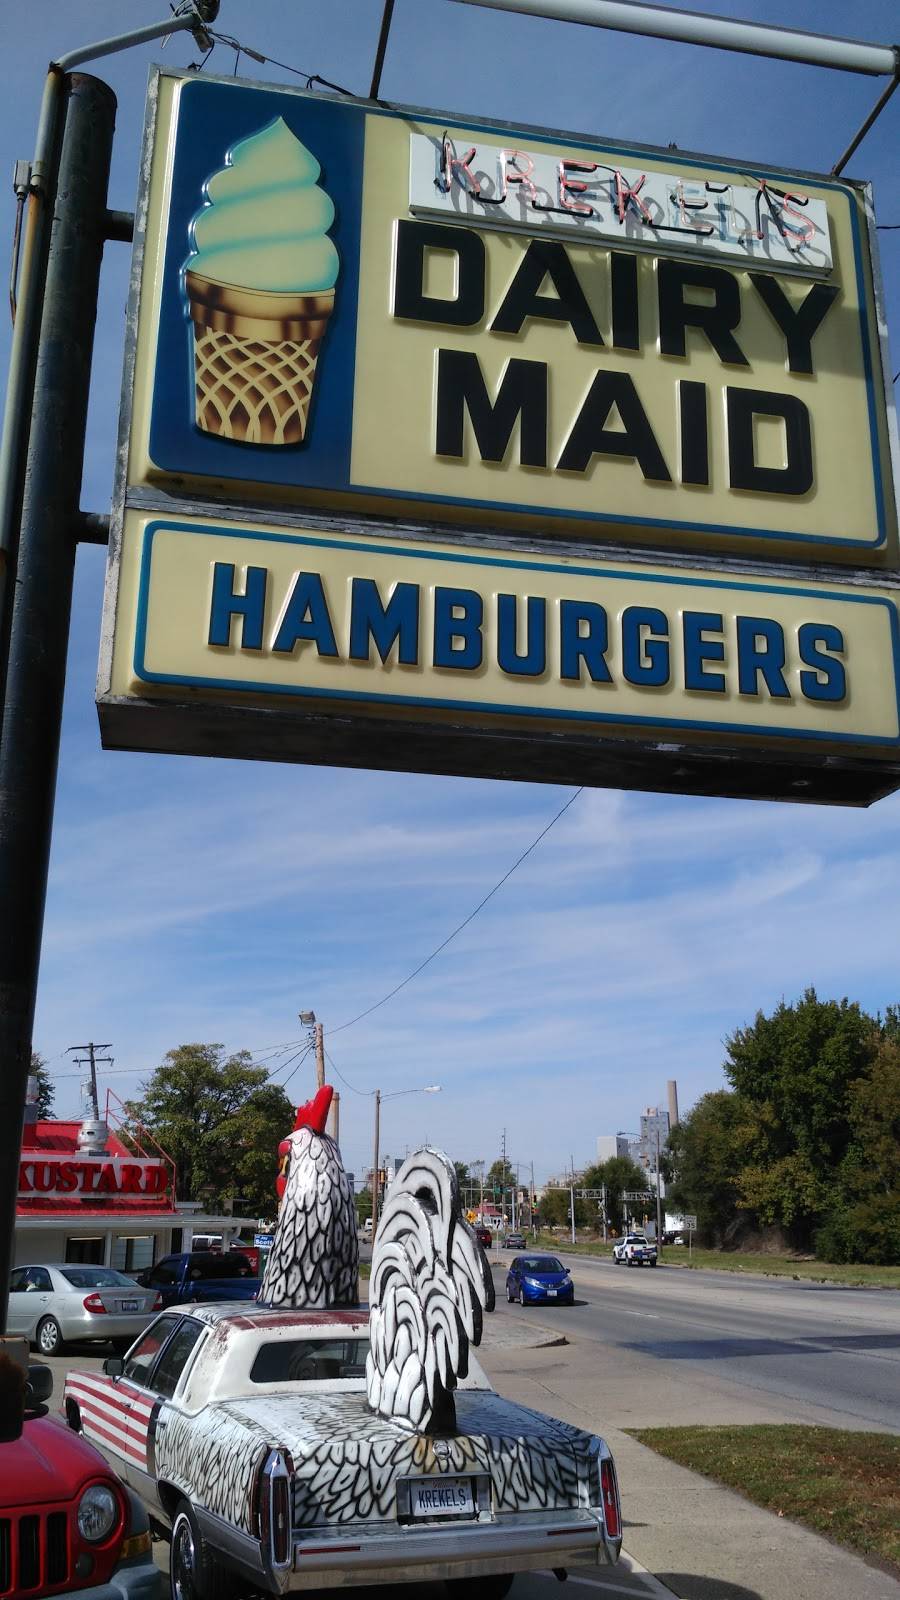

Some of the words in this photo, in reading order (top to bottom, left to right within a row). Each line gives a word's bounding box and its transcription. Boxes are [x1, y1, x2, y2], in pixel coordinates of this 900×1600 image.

[393, 219, 840, 375] DAIRY
[435, 348, 814, 495] MAID
[207, 561, 847, 701] HAMBURGERS
[18, 1161, 169, 1193] KUSTARD
[418, 1488, 466, 1508] KREKELS
